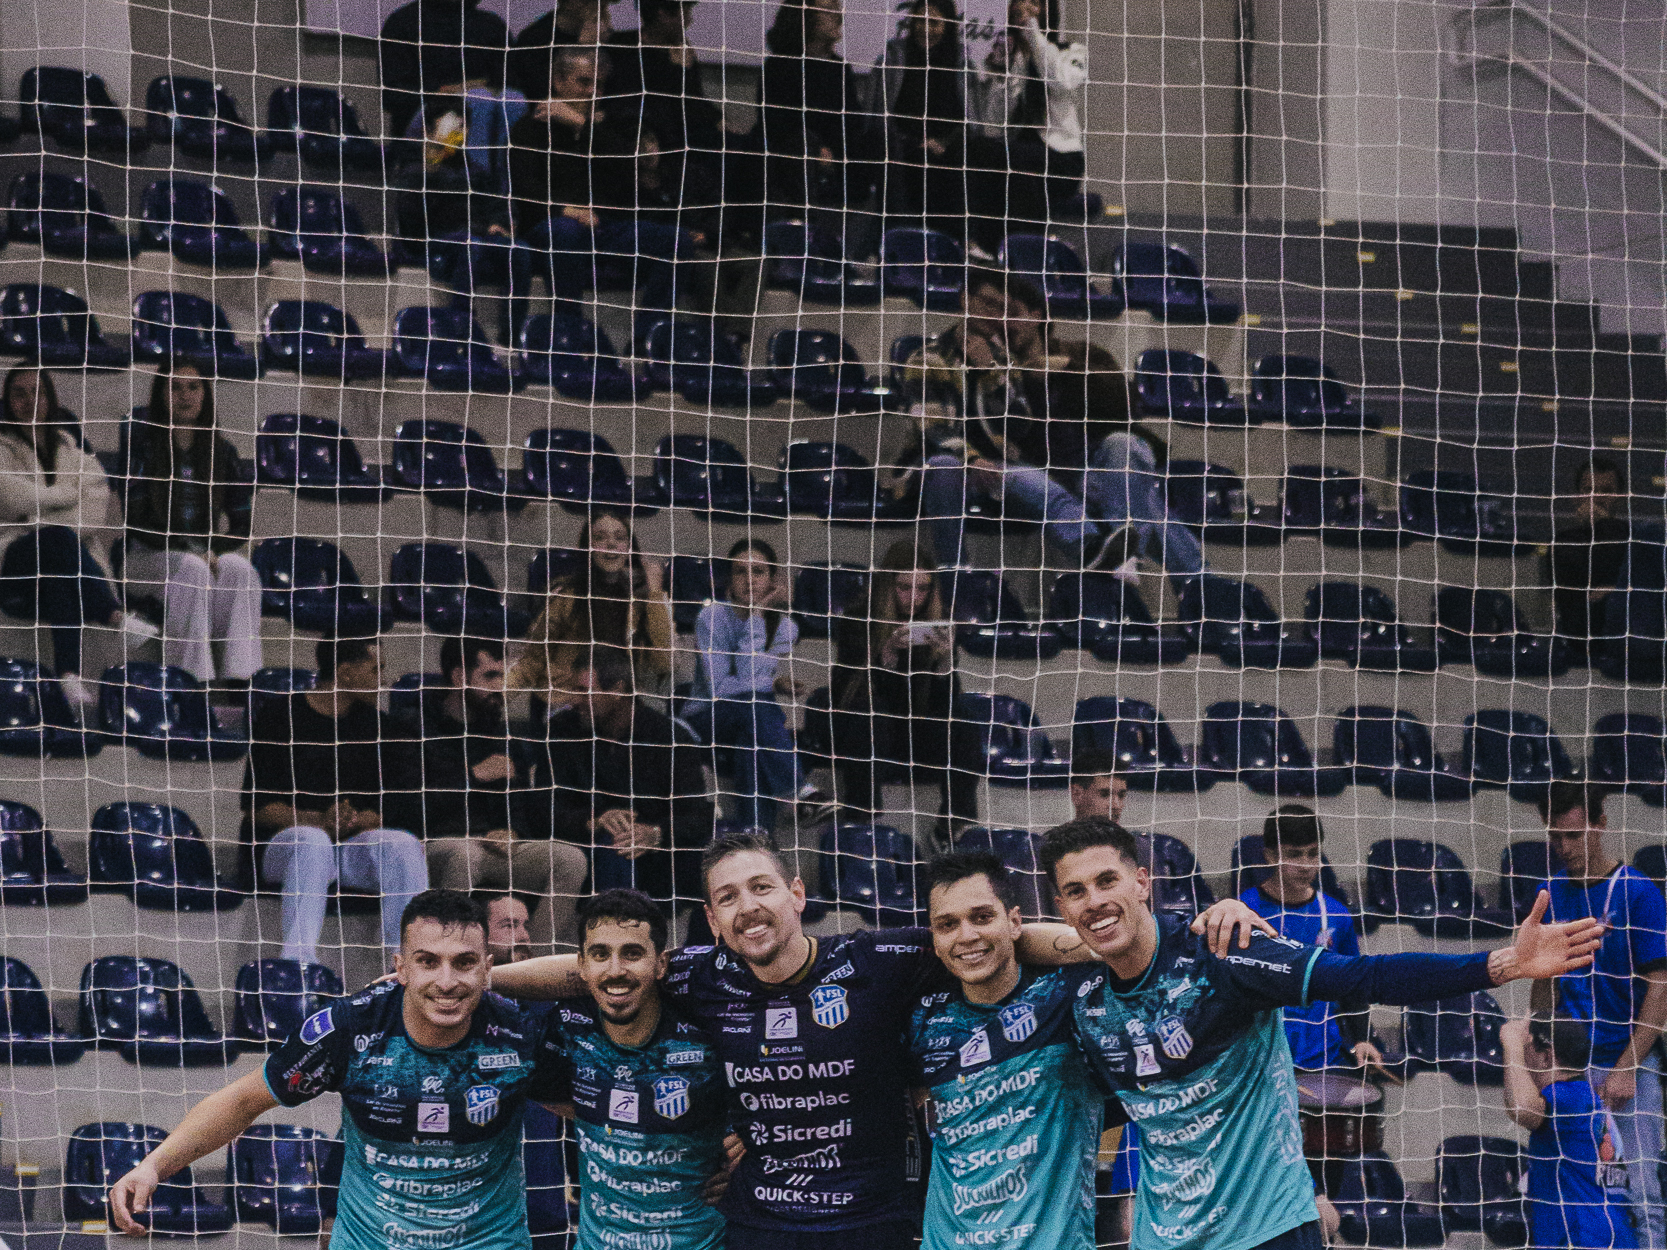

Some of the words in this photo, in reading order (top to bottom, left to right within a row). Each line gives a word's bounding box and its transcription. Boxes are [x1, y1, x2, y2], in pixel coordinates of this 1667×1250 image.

[480, 1056, 518, 1068] GREEN
[735, 1066, 775, 1083] CASA
[778, 1064, 803, 1081] DO
[808, 1059, 855, 1079] MDF
[975, 1084, 998, 1106] DO
[1000, 1066, 1041, 1095] MDF
[759, 1090, 851, 1112] fibraplac
[773, 1118, 852, 1142] Sicredi
[619, 1149, 643, 1166] DO
[966, 1134, 1039, 1172] Sicredi
